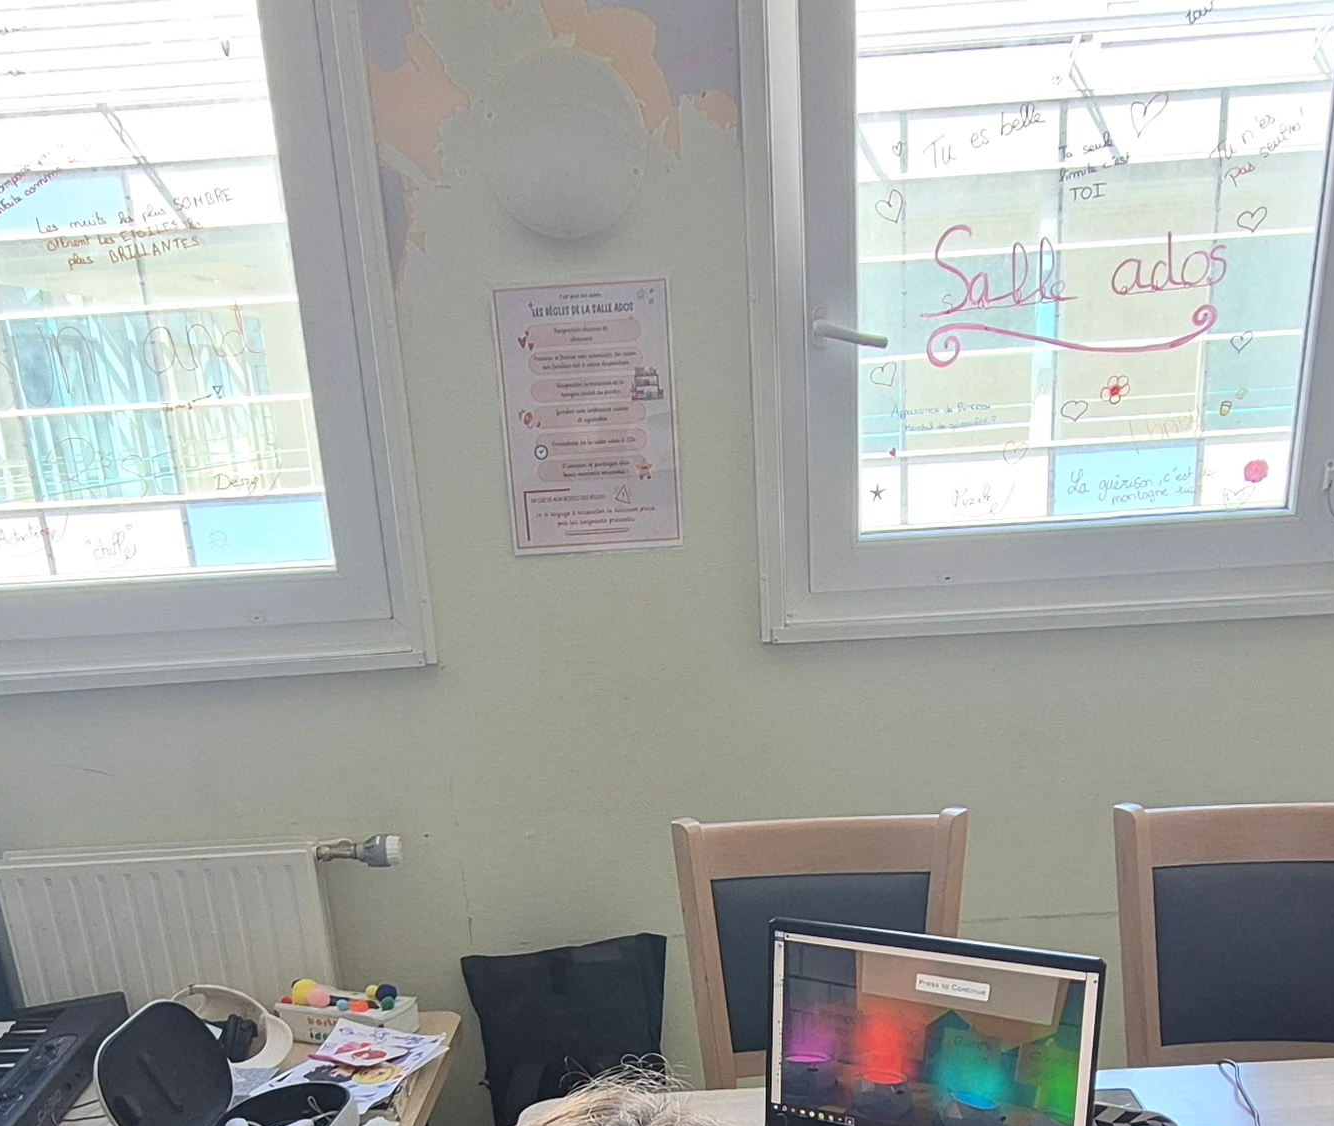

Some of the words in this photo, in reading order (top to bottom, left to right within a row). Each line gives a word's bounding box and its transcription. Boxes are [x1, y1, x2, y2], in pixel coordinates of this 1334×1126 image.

[923, 136, 957, 169] Tu
[970, 128, 989, 151] es
[1000, 102, 1046, 137] belle
[1058, 145, 1073, 160] Ta
[1083, 130, 1114, 155] seule
[1058, 162, 1099, 183] limite
[1224, 161, 1256, 188] pas
[1069, 182, 1108, 202] TOI
[35, 216, 59, 234] Les
[920, 224, 1078, 319] Salle
[1111, 230, 1227, 296] ados
[1067, 468, 1091, 495] La
